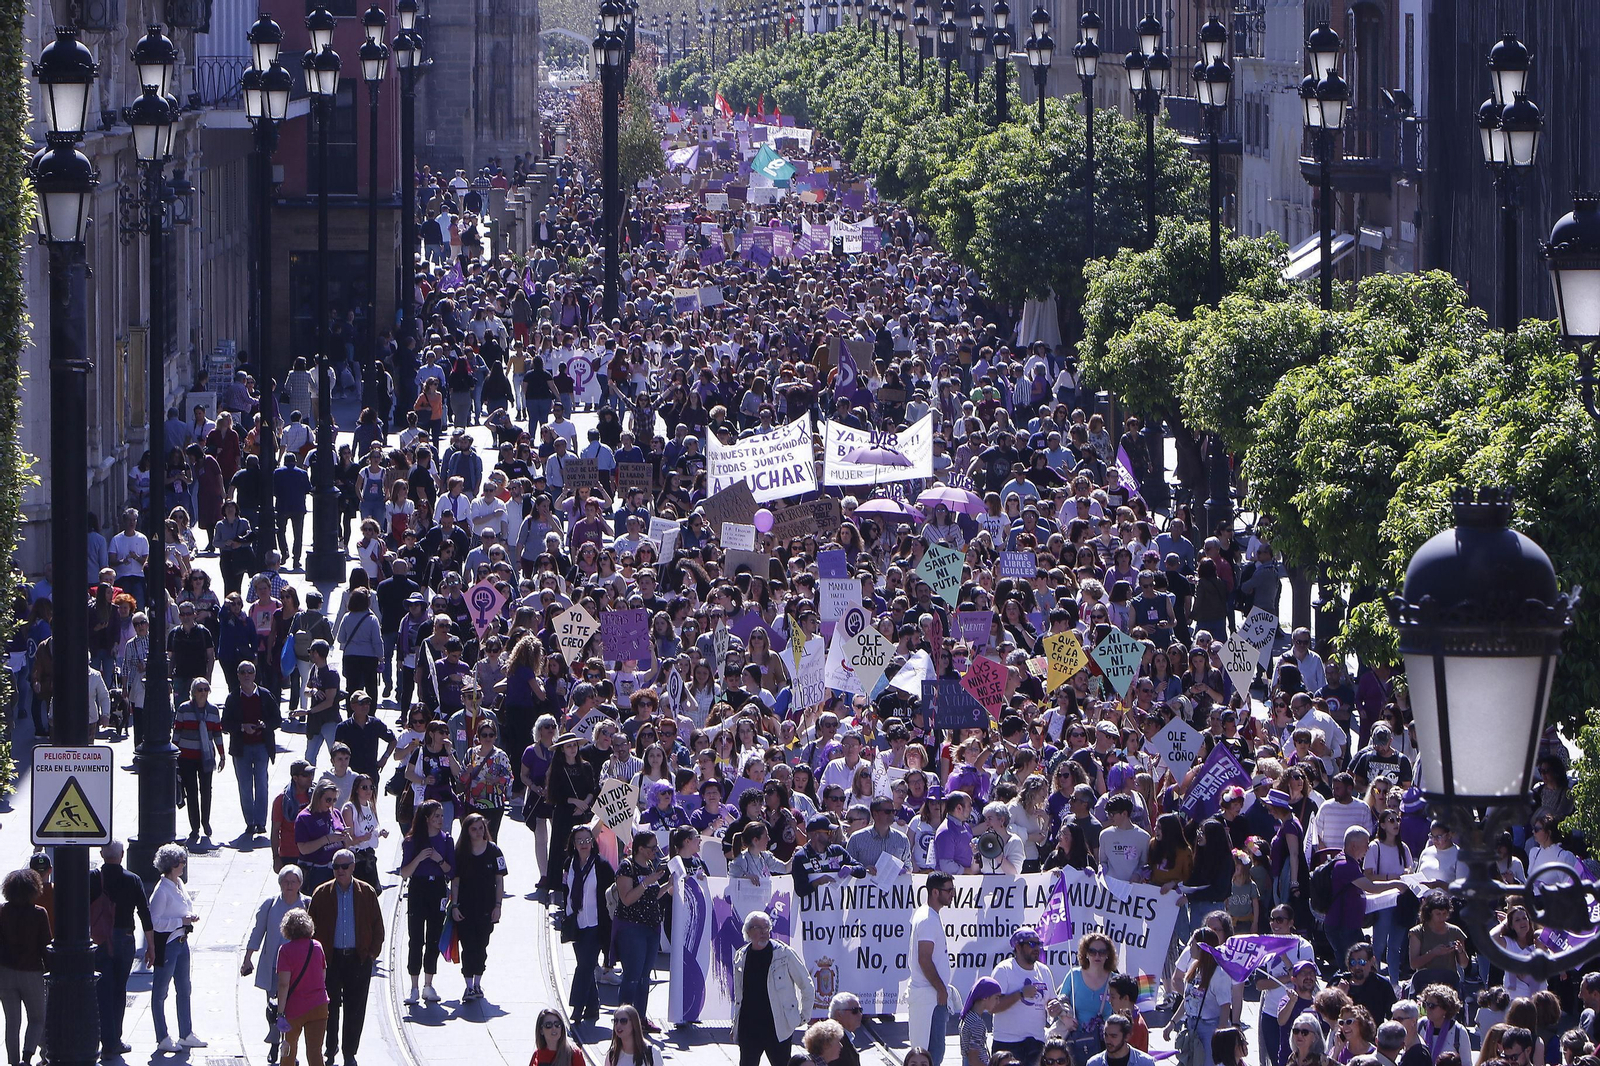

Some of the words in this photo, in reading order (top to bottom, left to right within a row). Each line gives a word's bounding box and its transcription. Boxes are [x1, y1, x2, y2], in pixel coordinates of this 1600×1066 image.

[721, 447, 765, 460] NUESTRA
[769, 436, 809, 454] DIGNIDAD
[753, 452, 794, 469] JUNTAS
[830, 470, 864, 480] MUJER
[928, 547, 940, 559] NI
[1006, 553, 1029, 562] VIVAS
[924, 552, 960, 572] SANTA
[1004, 559, 1032, 569] LIBRES
[935, 567, 950, 580] NI
[1002, 566, 1035, 576] IGUALES
[932, 575, 960, 592] PUTA
[569, 611, 582, 623] YO
[1242, 622, 1252, 633] EL
[1250, 612, 1274, 624] FUTURO
[562, 625, 573, 634] SI
[576, 626, 590, 637] TE
[1254, 624, 1264, 636] ES
[561, 637, 584, 649] CREO
[857, 634, 882, 647] OLE
[1058, 636, 1075, 648] QUE
[1108, 634, 1120, 645] NI
[862, 646, 878, 657] MI
[1051, 642, 1063, 652] TE
[1098, 643, 1140, 656] SANTA
[1227, 639, 1245, 653] OLE
[1051, 652, 1079, 667] CHUPE
[1111, 656, 1124, 667] NI
[1233, 652, 1245, 662] MI
[972, 661, 990, 674] LXS
[1052, 662, 1075, 676] SIRI
[1106, 666, 1135, 678] PUTA
[967, 669, 998, 690] NINXS
[976, 685, 988, 696] NO
[989, 682, 1002, 695] SE
[577, 724, 589, 734] EL
[1167, 730, 1187, 742] OLE
[1172, 742, 1182, 751] MI
[44, 752, 71, 760] PELIGRO
[72, 752, 81, 760] DE
[36, 764, 54, 772] CERA
[54, 764, 63, 772] EN
[64, 764, 72, 772] EL
[74, 764, 110, 772] PAVIMENTO
[599, 794, 609, 808] NI
[609, 783, 633, 801] TUYA
[605, 804, 616, 816] NI
[617, 798, 629, 810] DE
[608, 809, 634, 829] NADIE
[990, 885, 1018, 909] DE
[1068, 882, 1158, 921] MUJERES
[802, 920, 836, 945] Hoy
[839, 919, 867, 939] más
[872, 923, 904, 942] que
[1082, 921, 1150, 949] realidad
[856, 946, 888, 974] No,
